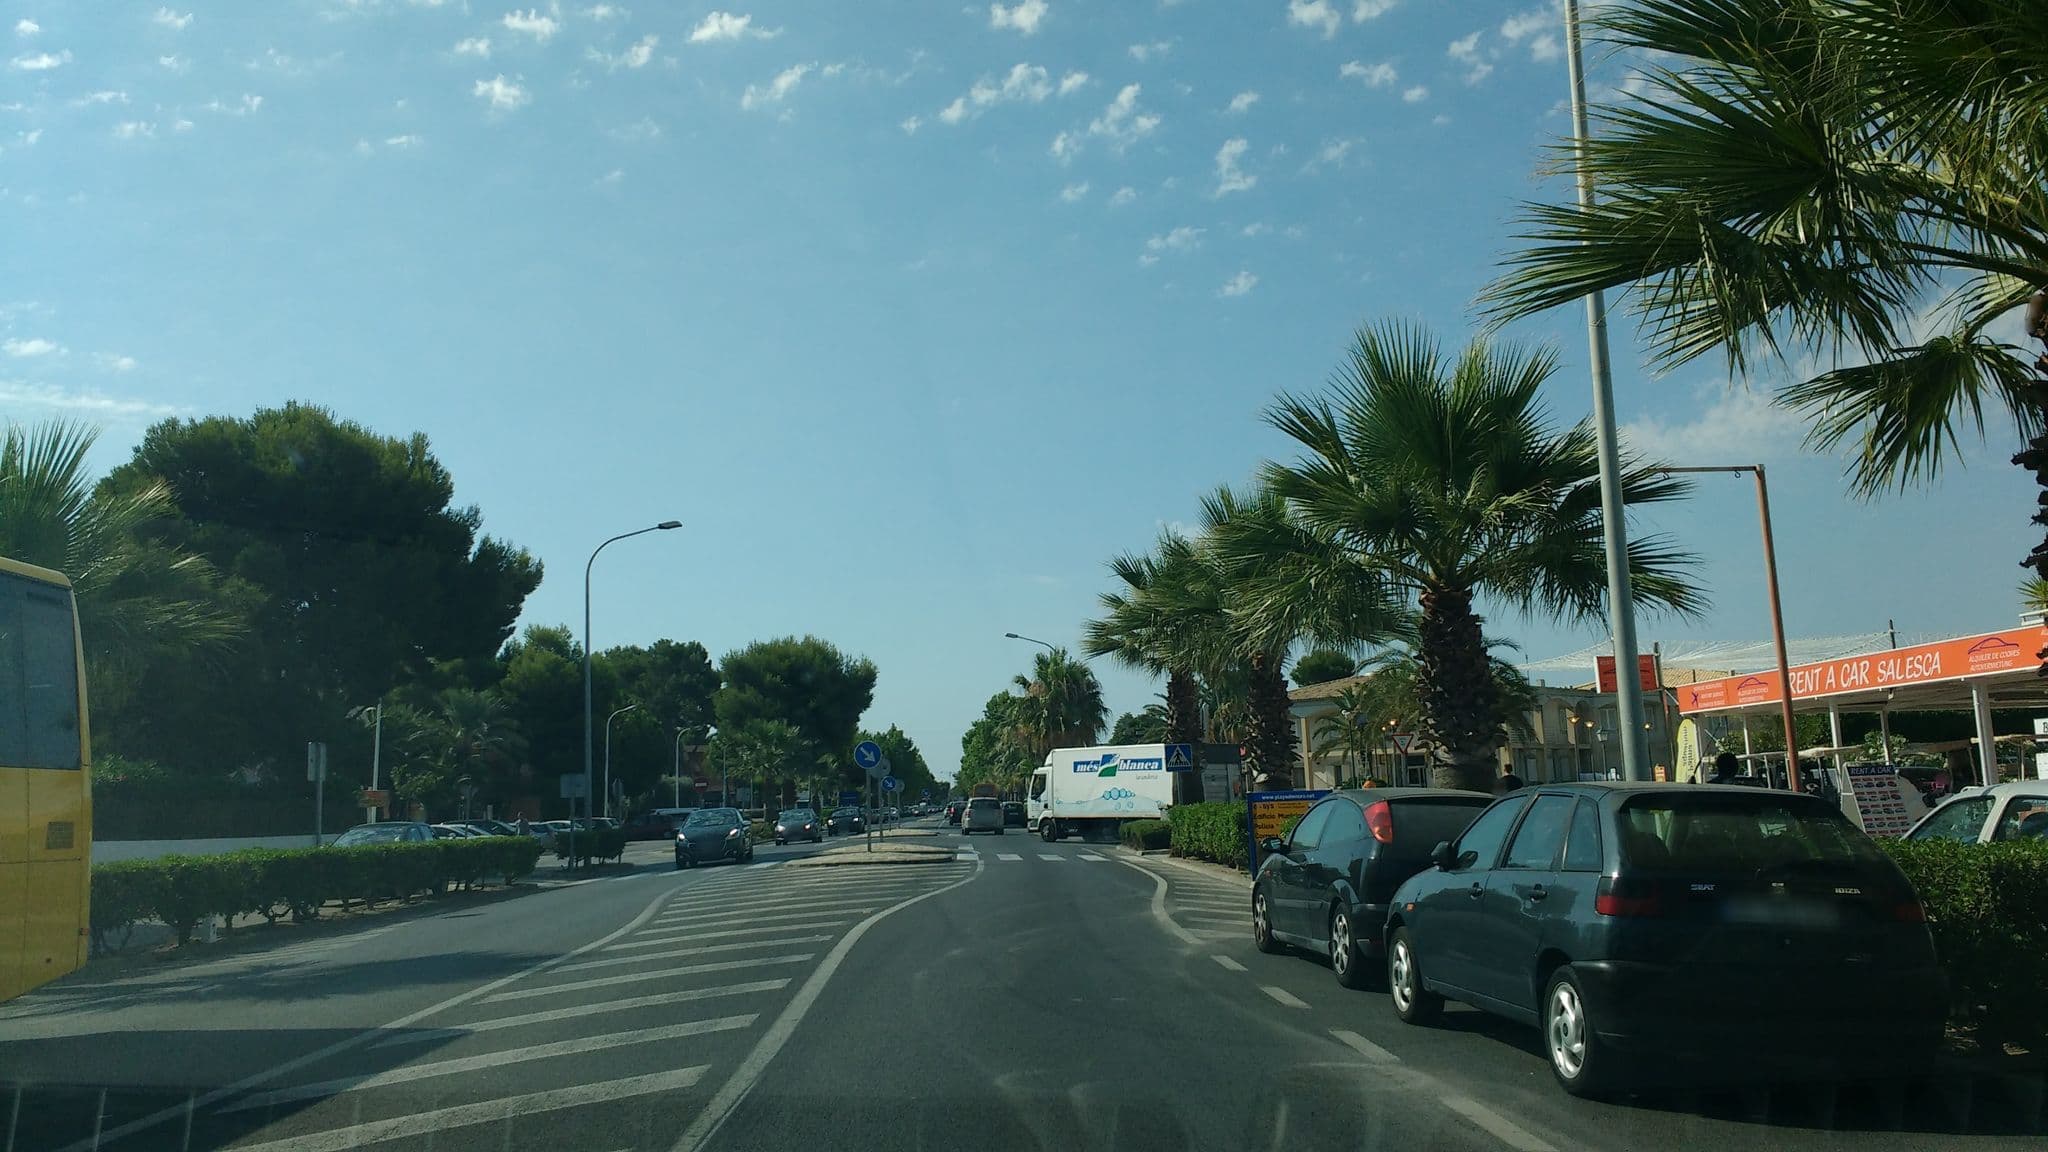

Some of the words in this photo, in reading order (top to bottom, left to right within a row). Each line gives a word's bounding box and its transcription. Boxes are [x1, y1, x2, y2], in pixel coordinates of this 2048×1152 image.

[1788, 667, 1823, 694] RENT
[1825, 665, 1836, 690] A
[1840, 660, 1870, 688] CAR
[1877, 651, 1942, 682] SALESCA
[1076, 760, 1098, 772] més
[1119, 759, 1158, 770] blanca
[1851, 767, 1868, 775] RENT
[1877, 766, 1892, 774] CAR
